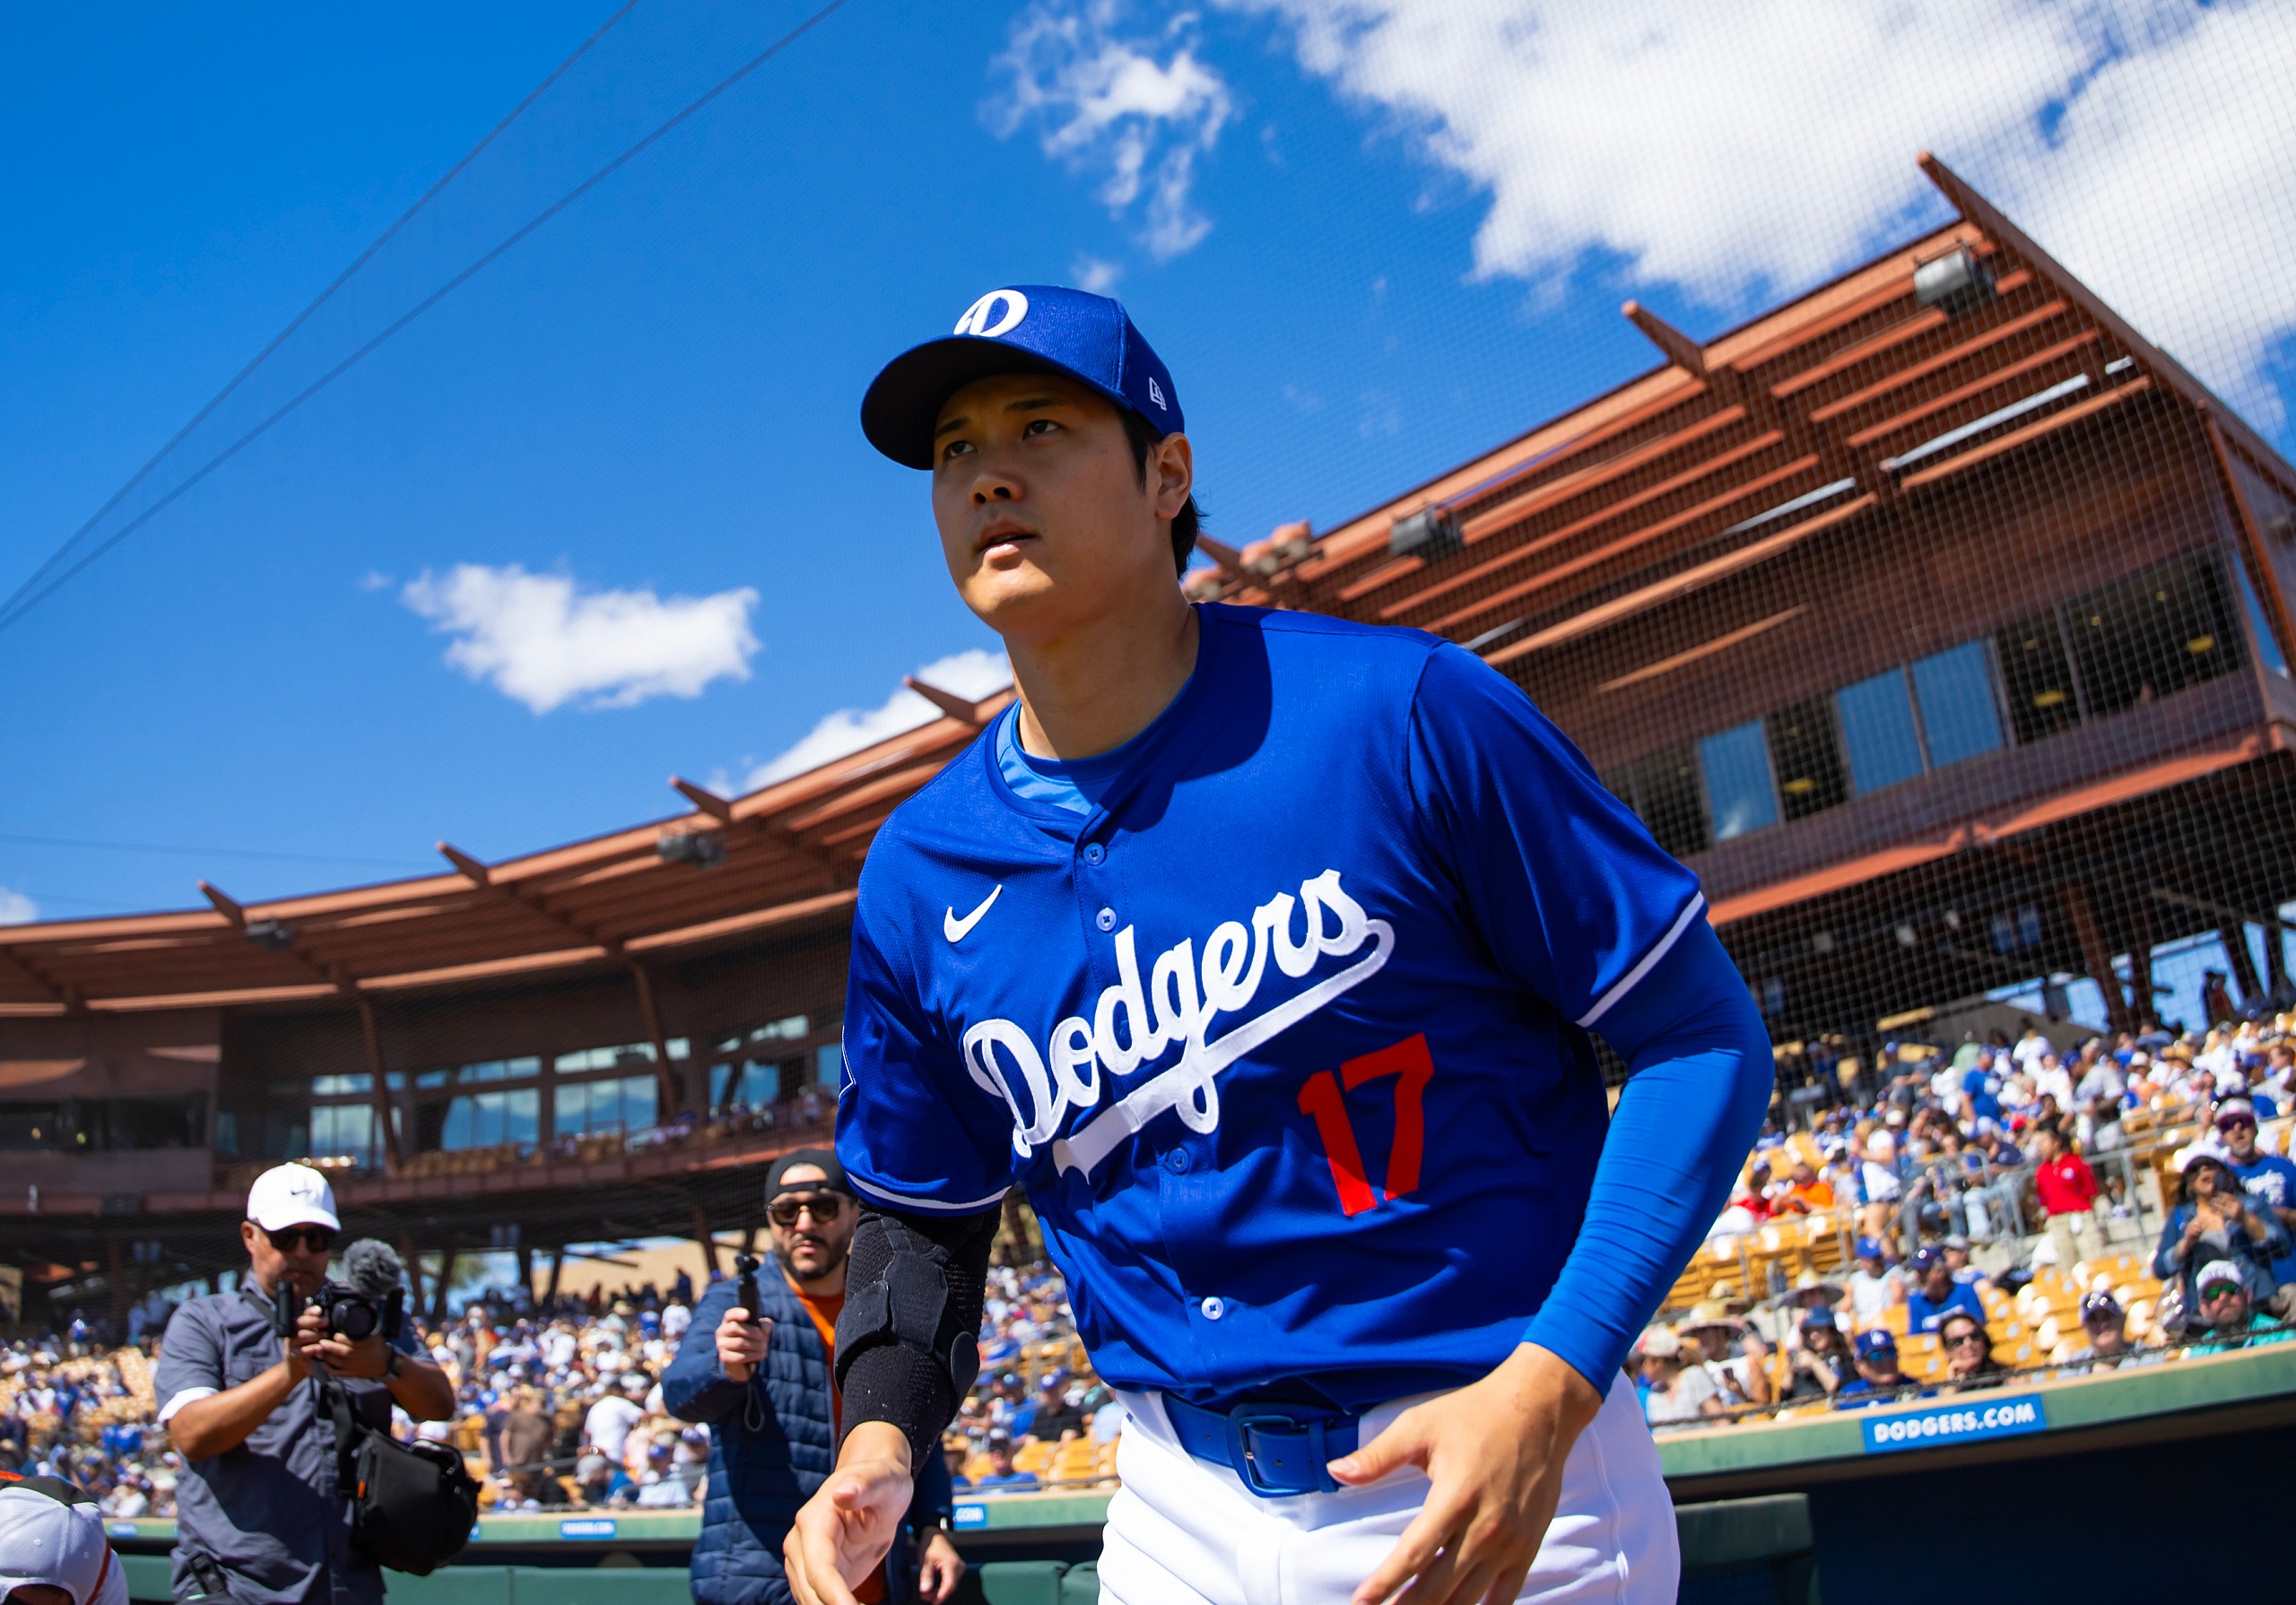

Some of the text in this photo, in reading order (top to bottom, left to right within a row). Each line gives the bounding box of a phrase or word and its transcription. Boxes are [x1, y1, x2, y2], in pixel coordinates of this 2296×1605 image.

[953, 289, 1029, 337] D
[963, 868, 1370, 1158] Dodgers
[1297, 1032, 1434, 1217] 17
[1874, 1402, 2037, 1444] DODGERS.COM
